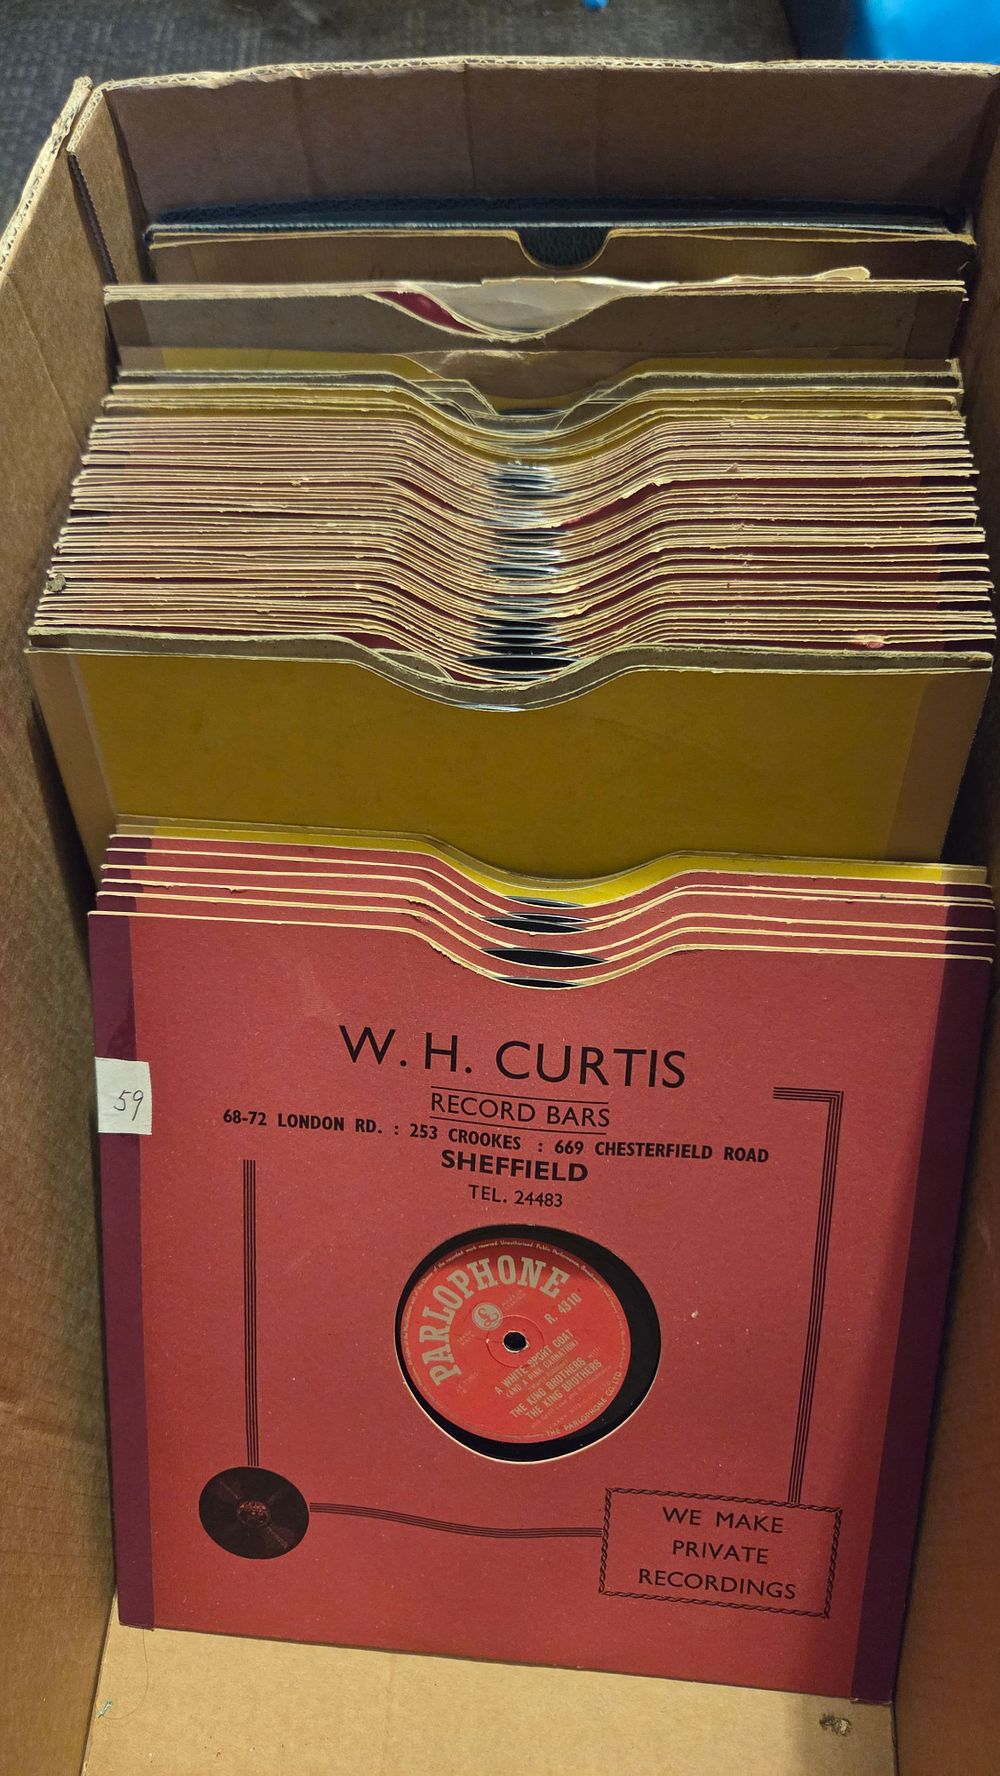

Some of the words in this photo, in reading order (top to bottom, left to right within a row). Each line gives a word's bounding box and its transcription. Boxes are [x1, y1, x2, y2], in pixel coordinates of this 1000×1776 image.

[339, 1025, 407, 1067] W.
[424, 1032, 472, 1074] H.
[495, 1040, 685, 1089] CURTIS
[113, 1089, 144, 1121] 59
[430, 1092, 536, 1123] RECORD
[546, 1105, 610, 1128] BARS
[223, 1109, 267, 1126] 68-72
[277, 1113, 344, 1131] LONDON
[355, 1119, 383, 1134] RD.
[409, 1123, 438, 1139] 253
[448, 1128, 521, 1151] CROOKES
[554, 1140, 584, 1155] 669
[594, 1141, 713, 1159] CHESTERFIELD
[723, 1146, 769, 1162] ROAD
[441, 1149, 588, 1182] SHEFFIELD
[468, 1184, 507, 1204] TEL.
[514, 1190, 563, 1208] 24483
[419, 1255, 570, 1386] PARLOPHONE
[544, 1313, 558, 1324] R.
[557, 1292, 582, 1313] 4310
[494, 1386, 503, 1395] A
[503, 1366, 528, 1388] WHITE
[528, 1345, 553, 1367] SPORT
[552, 1329, 574, 1348] COAT
[510, 1403, 528, 1418] THE
[527, 1387, 546, 1405] KING
[546, 1357, 586, 1390] BROTHERS
[525, 1406, 543, 1419] THE
[543, 1390, 563, 1408] KING
[561, 1359, 602, 1392] BROTHERS
[563, 1397, 608, 1431] PARLOPHONE
[662, 1506, 701, 1525] WE
[716, 1512, 784, 1533] MAKE
[672, 1540, 769, 1564] PRIVATE
[638, 1568, 796, 1599] RECORDINGS
